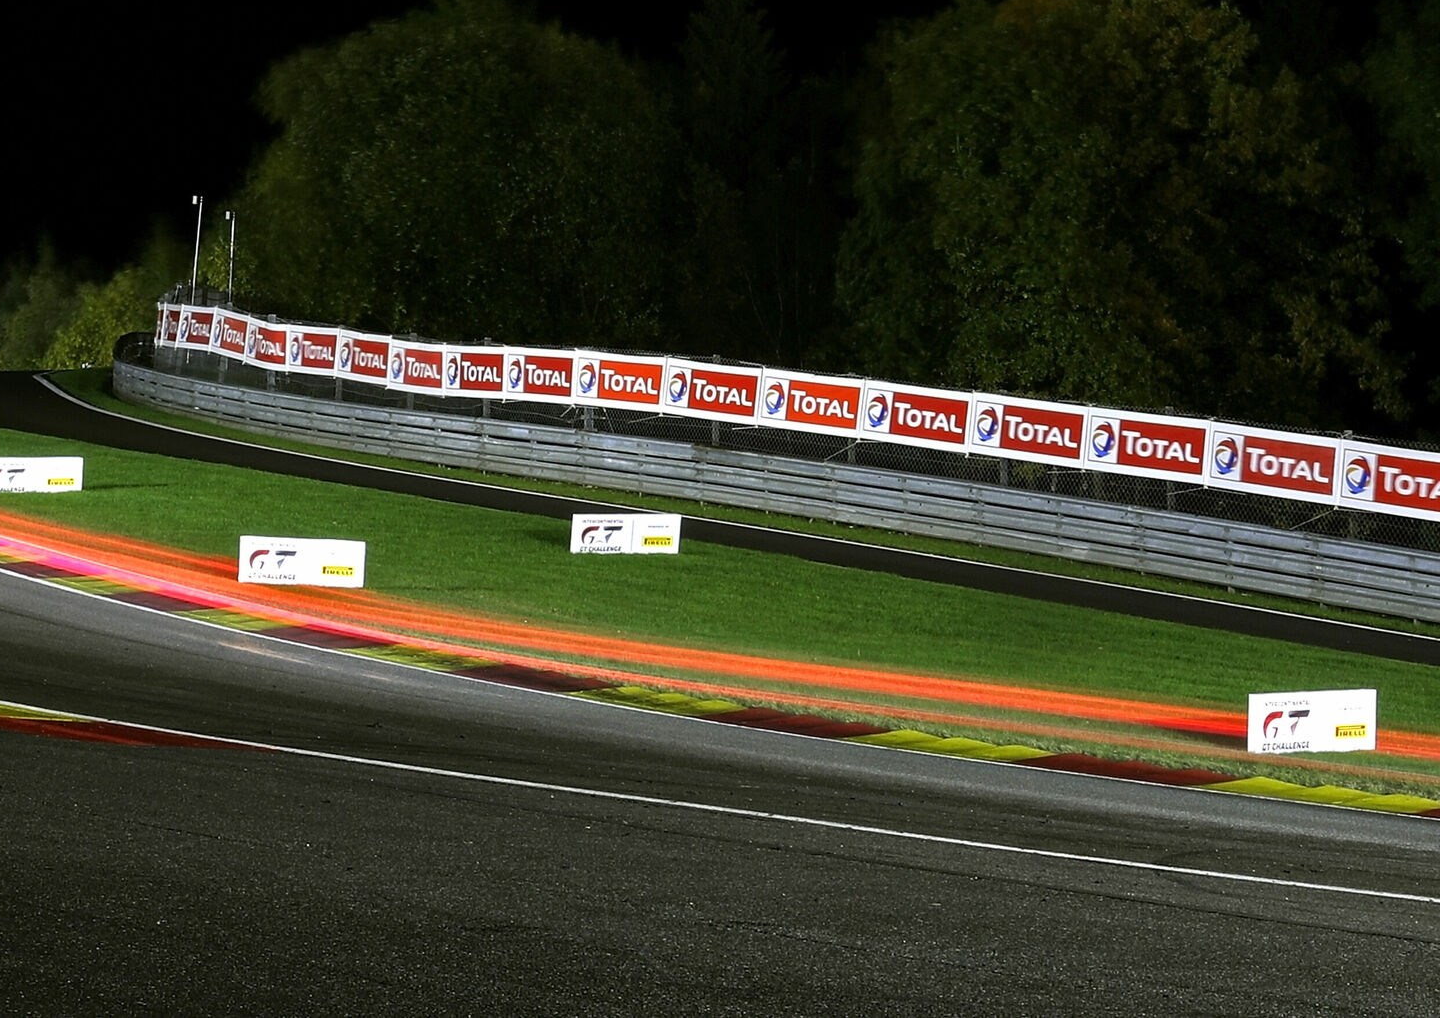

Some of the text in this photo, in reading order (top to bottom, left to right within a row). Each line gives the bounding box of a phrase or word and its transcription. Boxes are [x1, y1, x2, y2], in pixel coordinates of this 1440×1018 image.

[223, 324, 244, 346] TOTAL
[256, 331, 285, 357] TOTAL
[302, 340, 334, 361] TOTAL
[353, 347, 386, 369] TOTAL
[406, 356, 441, 379] TOTAL
[461, 360, 501, 383] TOTAL
[525, 364, 571, 387] TOTAL
[601, 369, 659, 395] TOTAL
[692, 379, 753, 407] TOTAL
[790, 390, 855, 419] TOTAL
[891, 403, 963, 435] TOTAL
[1005, 415, 1077, 448] TOTAL
[1121, 430, 1200, 463] TOTAL
[1247, 447, 1330, 483] TOTAL
[644, 538, 671, 546] PIRELLI
[322, 566, 353, 576] PIRELLI
[1336, 724, 1366, 737] PIRELLI
[1262, 742, 1310, 751] GT CHALLENGE
